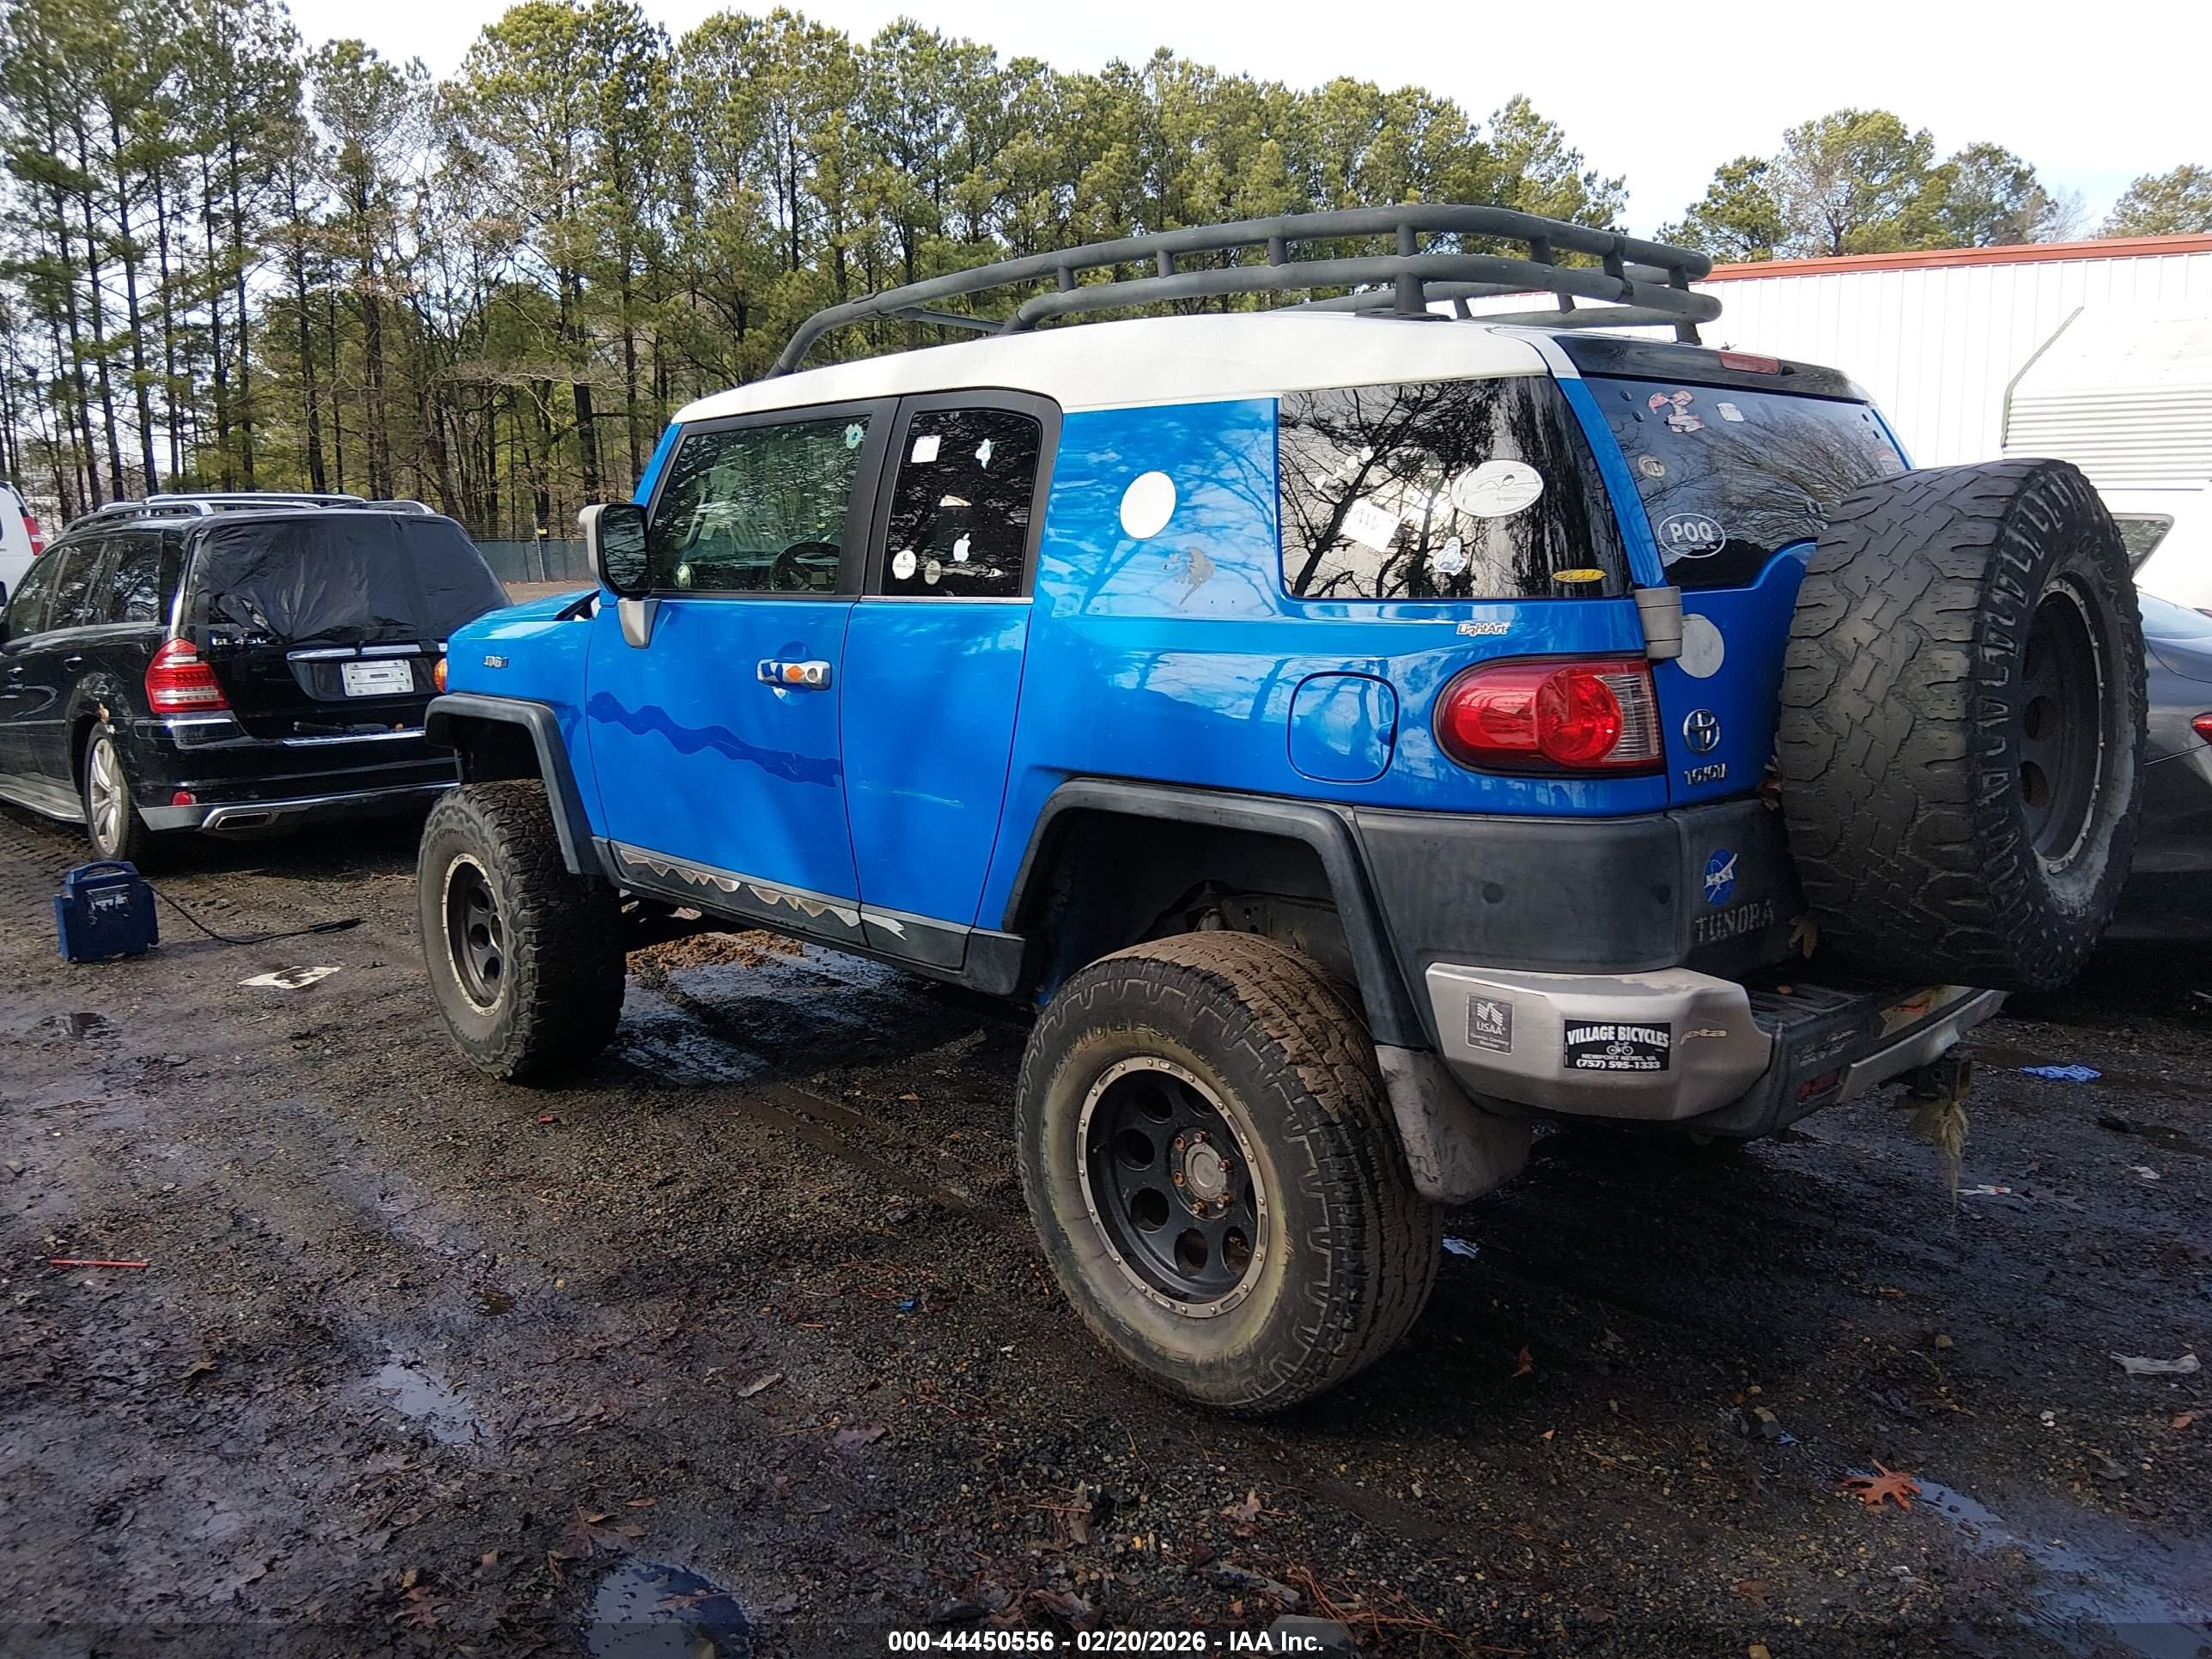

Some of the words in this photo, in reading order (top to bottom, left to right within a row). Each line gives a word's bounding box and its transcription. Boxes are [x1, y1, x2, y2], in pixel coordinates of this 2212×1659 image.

[1668, 522, 1715, 542] POQ
[1477, 1021, 1503, 1036] USAA
[1566, 1025, 1615, 1046] VILLAGE
[1617, 1026, 1669, 1048] BICYCLES
[1576, 1058, 1607, 1070] (757)
[1607, 1060, 1661, 1070] 595-1333
